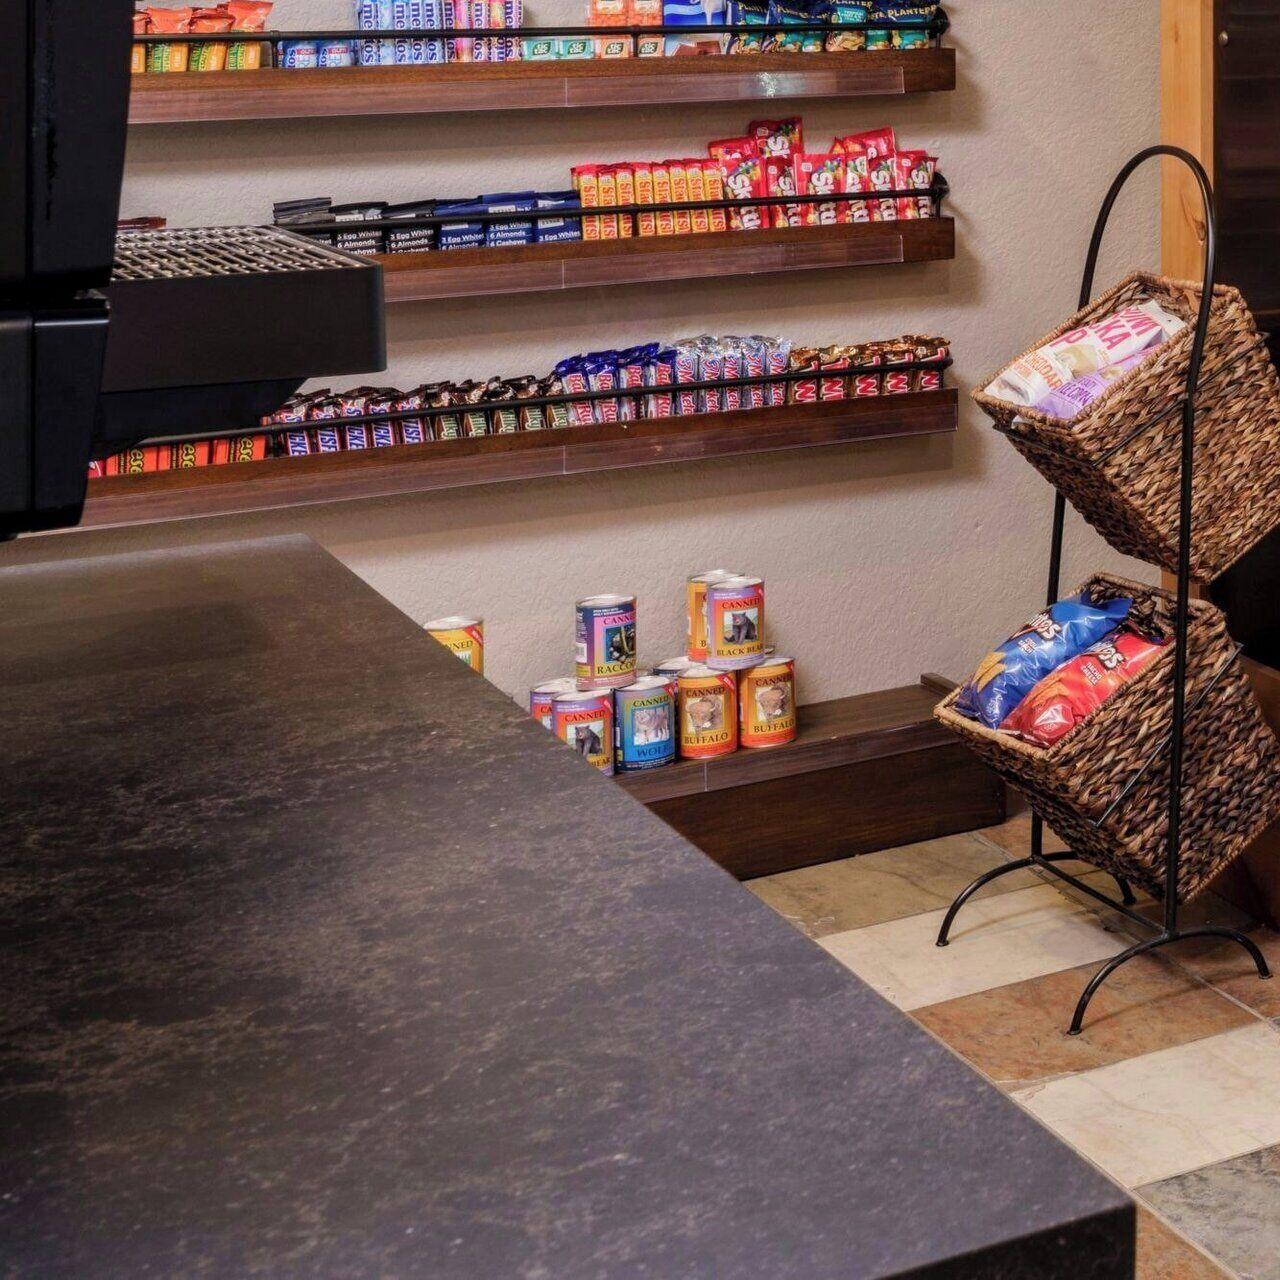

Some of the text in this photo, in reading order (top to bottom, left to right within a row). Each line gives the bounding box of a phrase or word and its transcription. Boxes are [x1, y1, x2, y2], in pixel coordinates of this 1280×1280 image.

[396, 232, 410, 241] Egg
[496, 230, 526, 239] Almonds
[544, 233, 558, 242] Egg
[344, 239, 376, 248] Almonds
[397, 239, 429, 248] Almonds
[721, 598, 759, 610] CANNED
[716, 646, 745, 657] BLACK
[755, 674, 795, 688] CANNED
[685, 686, 725, 699] CANNED
[632, 695, 670, 709] CANNED
[564, 710, 606, 722] CANNED
[753, 721, 794, 734] BUFFALO
[684, 732, 729, 745] BUFFALO
[636, 744, 672, 758] WOLF
